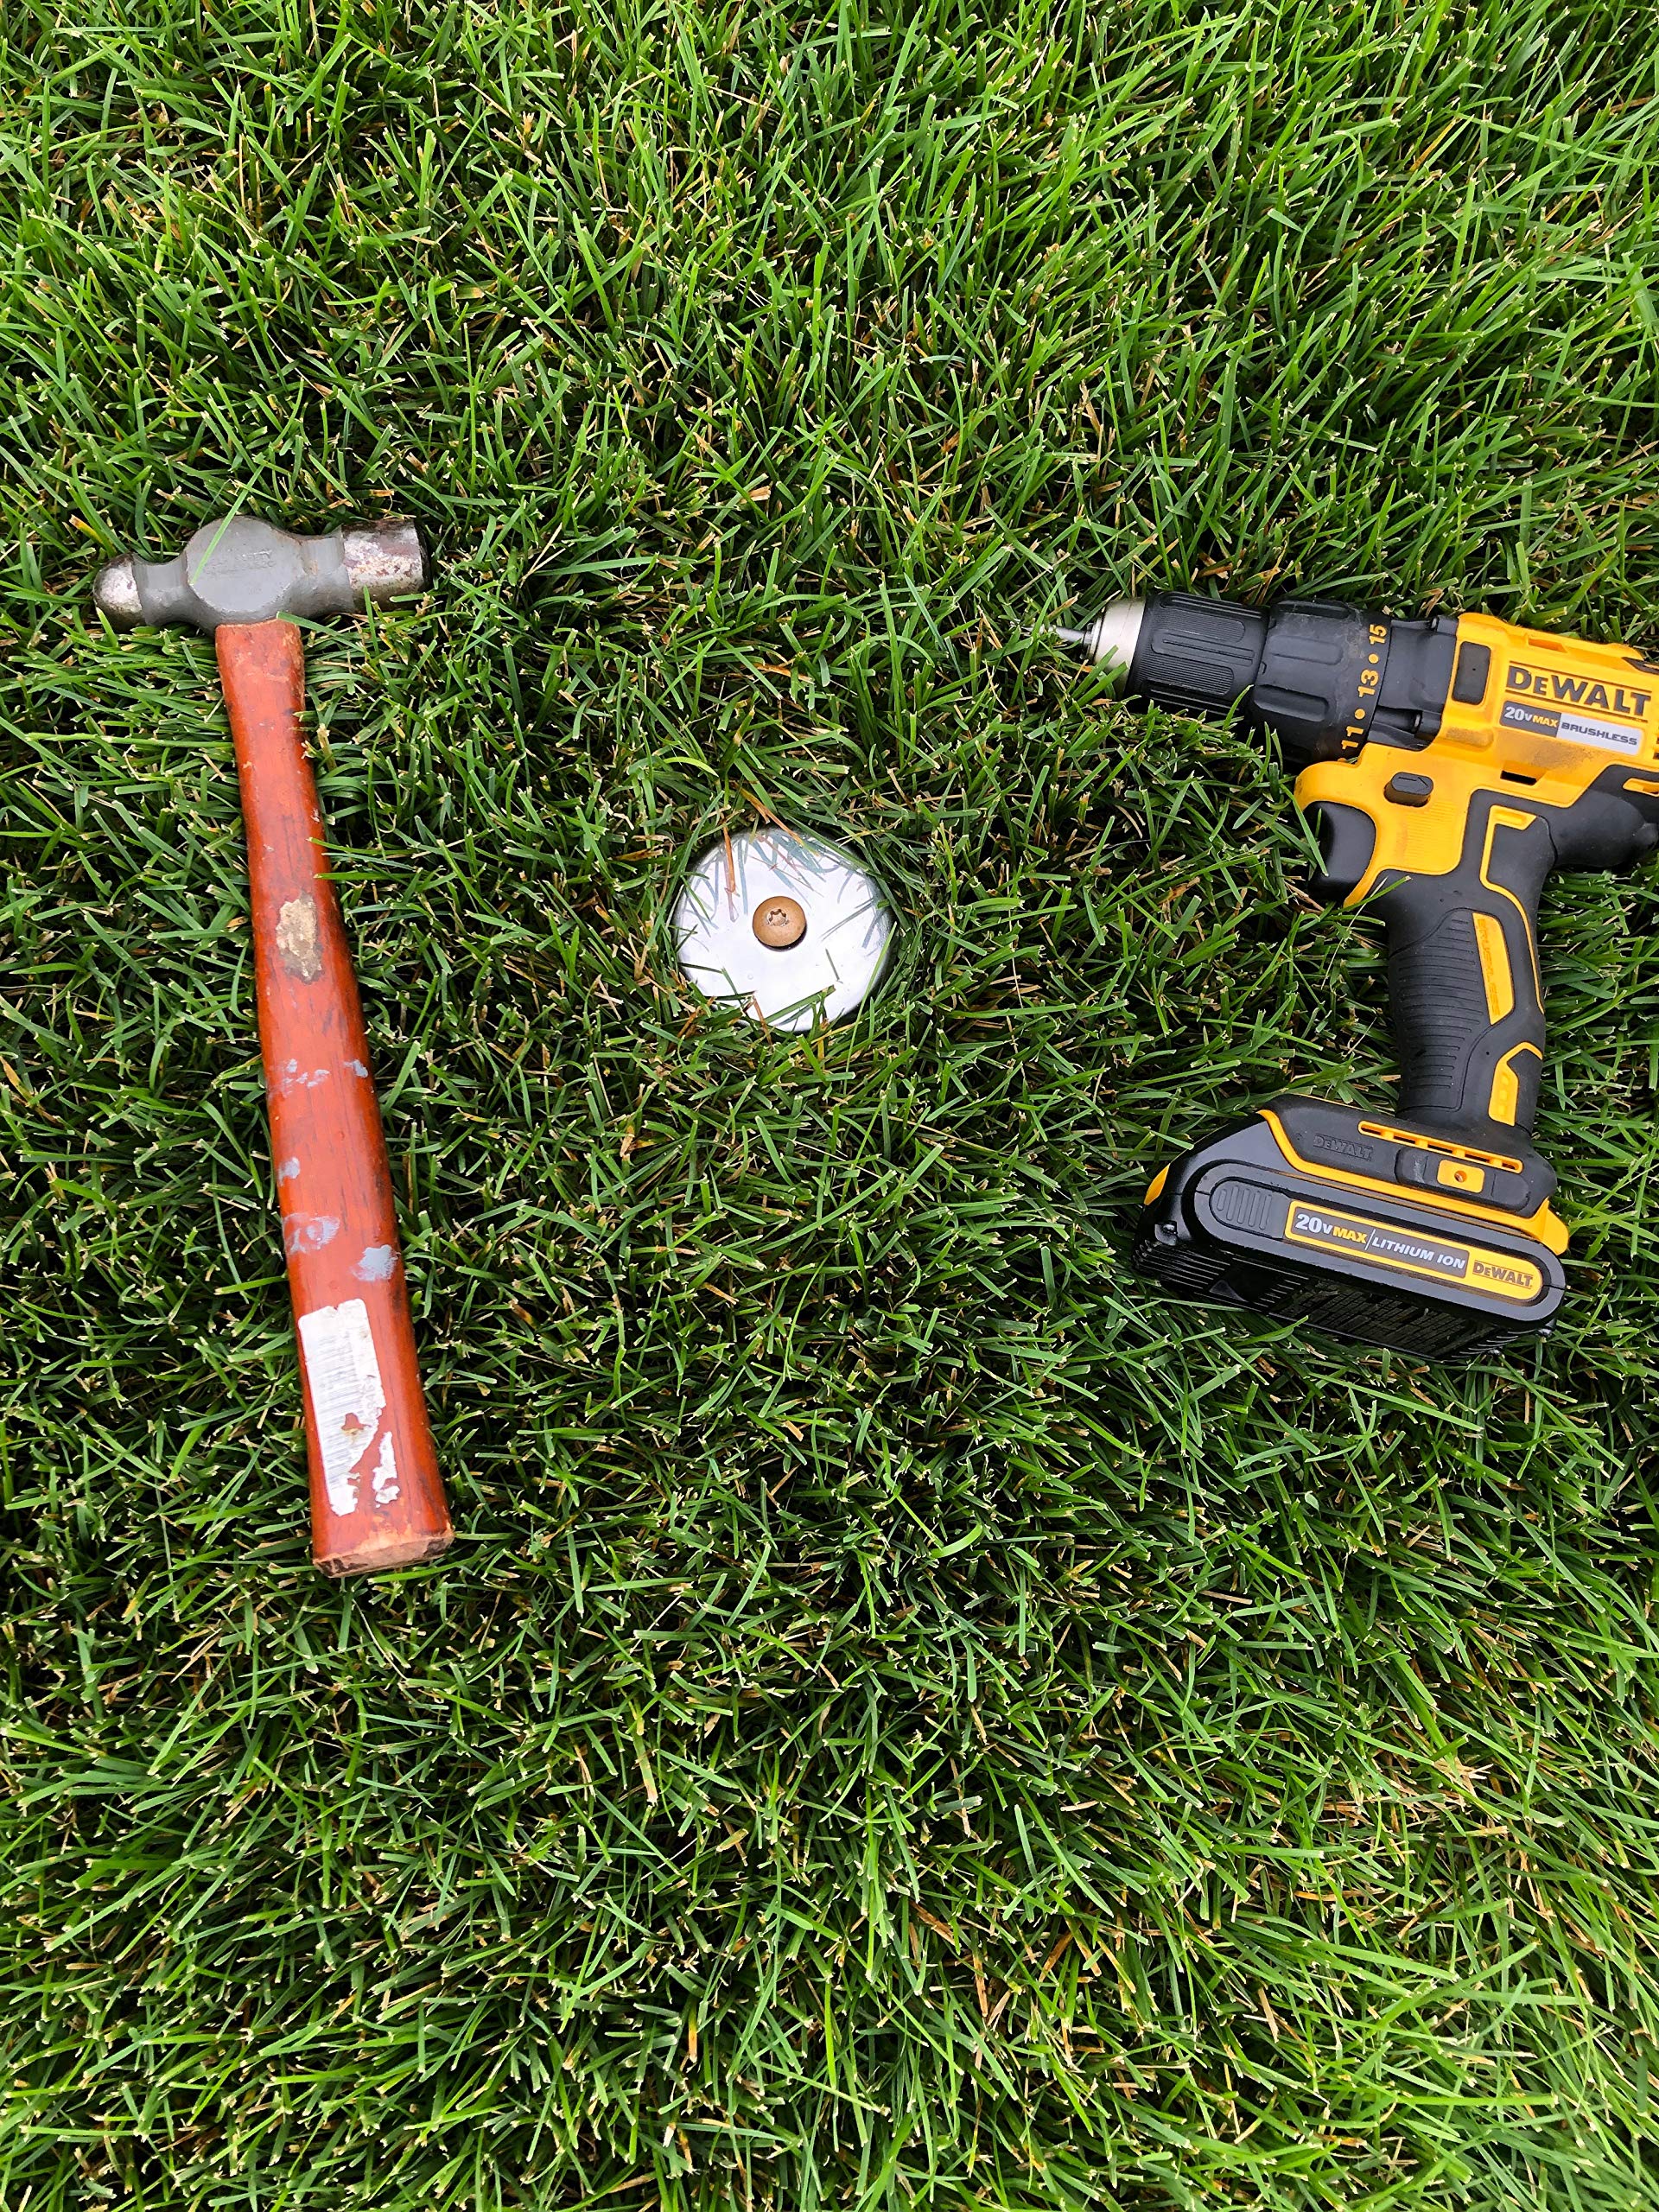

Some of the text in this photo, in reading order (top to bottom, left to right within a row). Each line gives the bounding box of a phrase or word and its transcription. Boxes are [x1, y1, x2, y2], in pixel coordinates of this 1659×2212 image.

[1341, 624, 1387, 750] 11 13 15
[1560, 721, 1638, 746] BRUSHLESS
[1477, 918, 1501, 1016] BRUSHLESS
[1371, 1236, 1435, 1262] LITHIUM
[1436, 1254, 1466, 1270] ION
